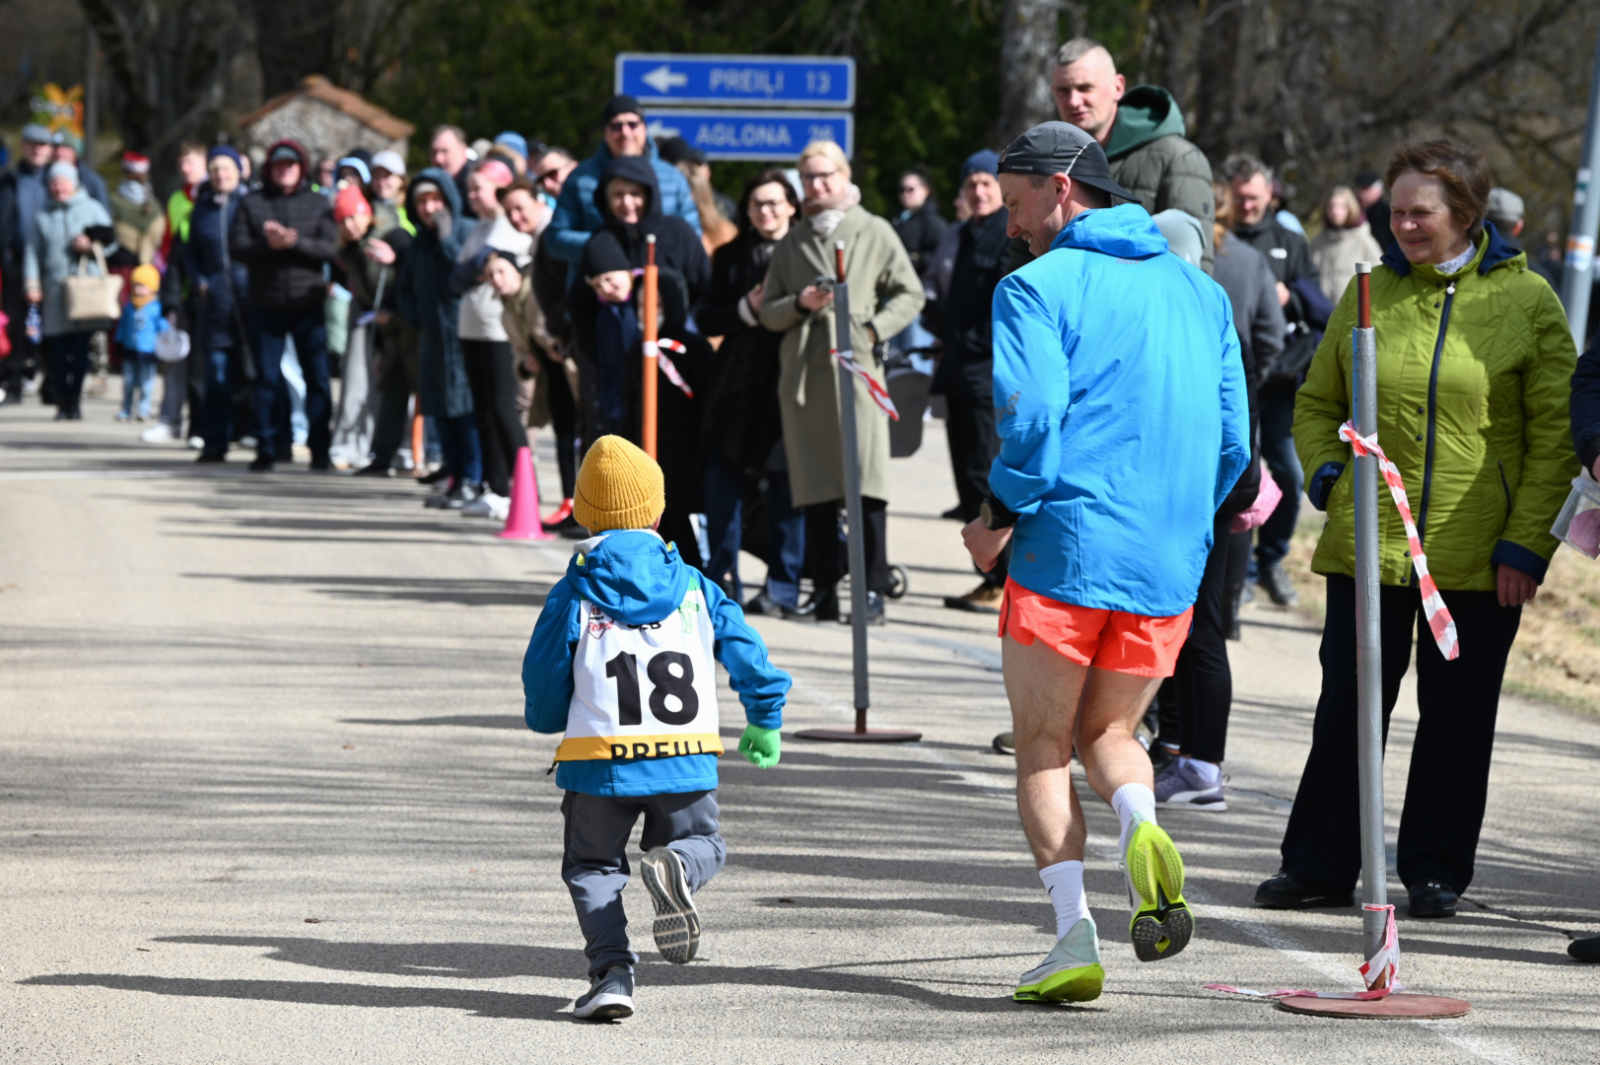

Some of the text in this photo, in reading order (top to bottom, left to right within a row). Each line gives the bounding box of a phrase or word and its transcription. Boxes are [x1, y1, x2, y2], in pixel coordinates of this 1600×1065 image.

[709, 68, 831, 98] PREIĻI 13
[695, 123, 792, 147] AGLONA
[605, 650, 699, 726] 18
